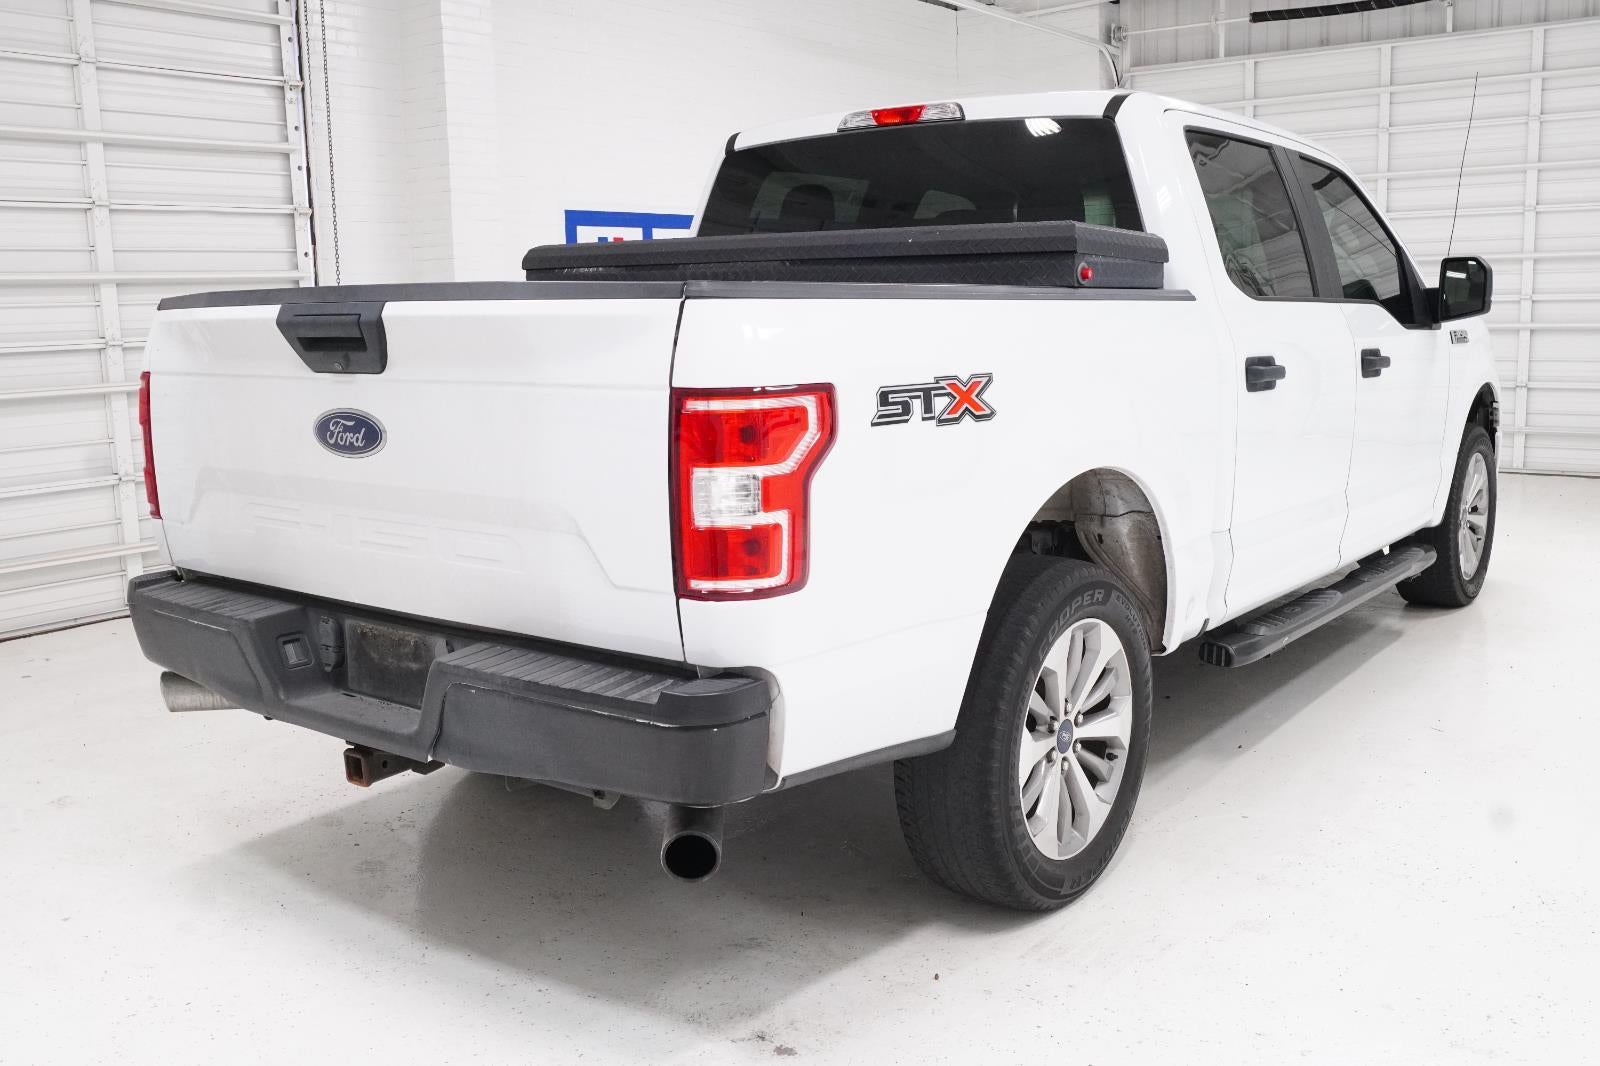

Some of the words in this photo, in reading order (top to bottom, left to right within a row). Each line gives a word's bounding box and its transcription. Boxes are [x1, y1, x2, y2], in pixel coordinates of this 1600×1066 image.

[871, 373, 996, 426] STX
[327, 419, 365, 446] Ford
[1038, 588, 1105, 662] COOPER
